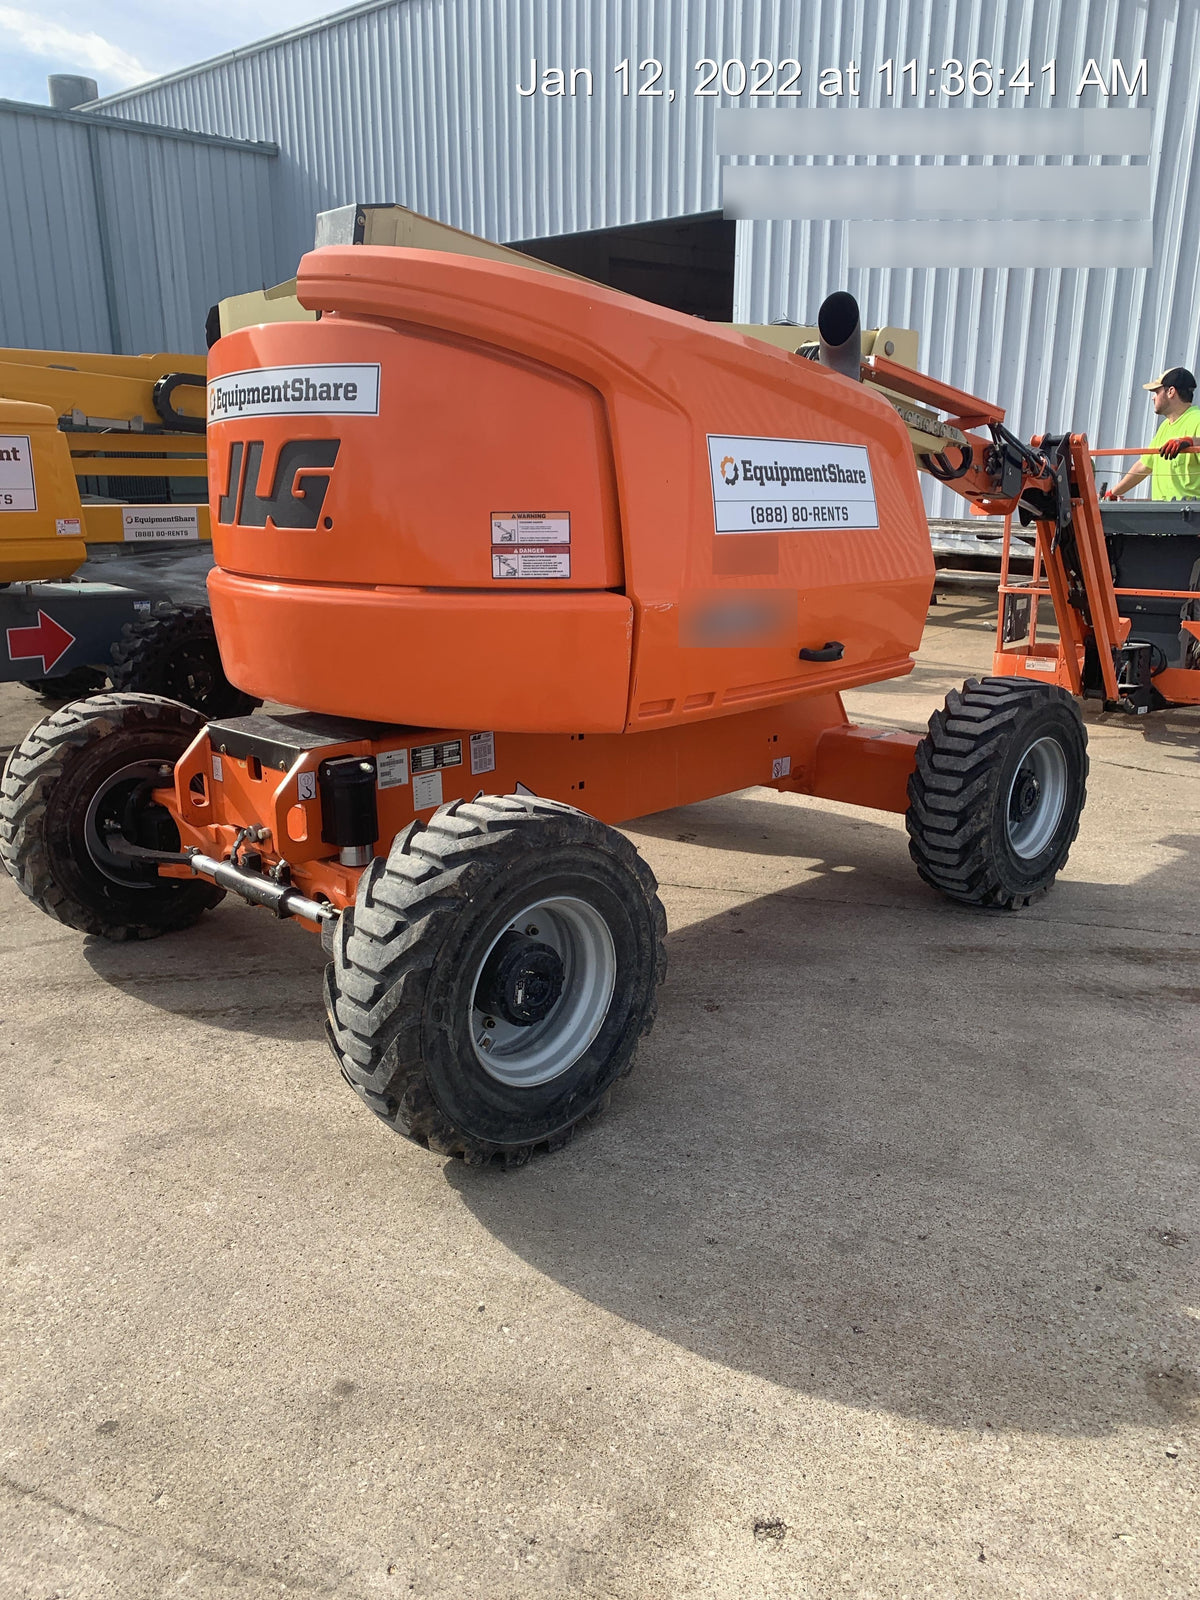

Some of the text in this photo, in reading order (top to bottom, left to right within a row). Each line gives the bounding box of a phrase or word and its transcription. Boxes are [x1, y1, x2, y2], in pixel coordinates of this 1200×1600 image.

[216, 377, 358, 413] EquipmentShare
[741, 459, 867, 486] EquipmentShare
[134, 516, 195, 524] EquipmentShare
[750, 505, 849, 524] (888) 80-RENTS
